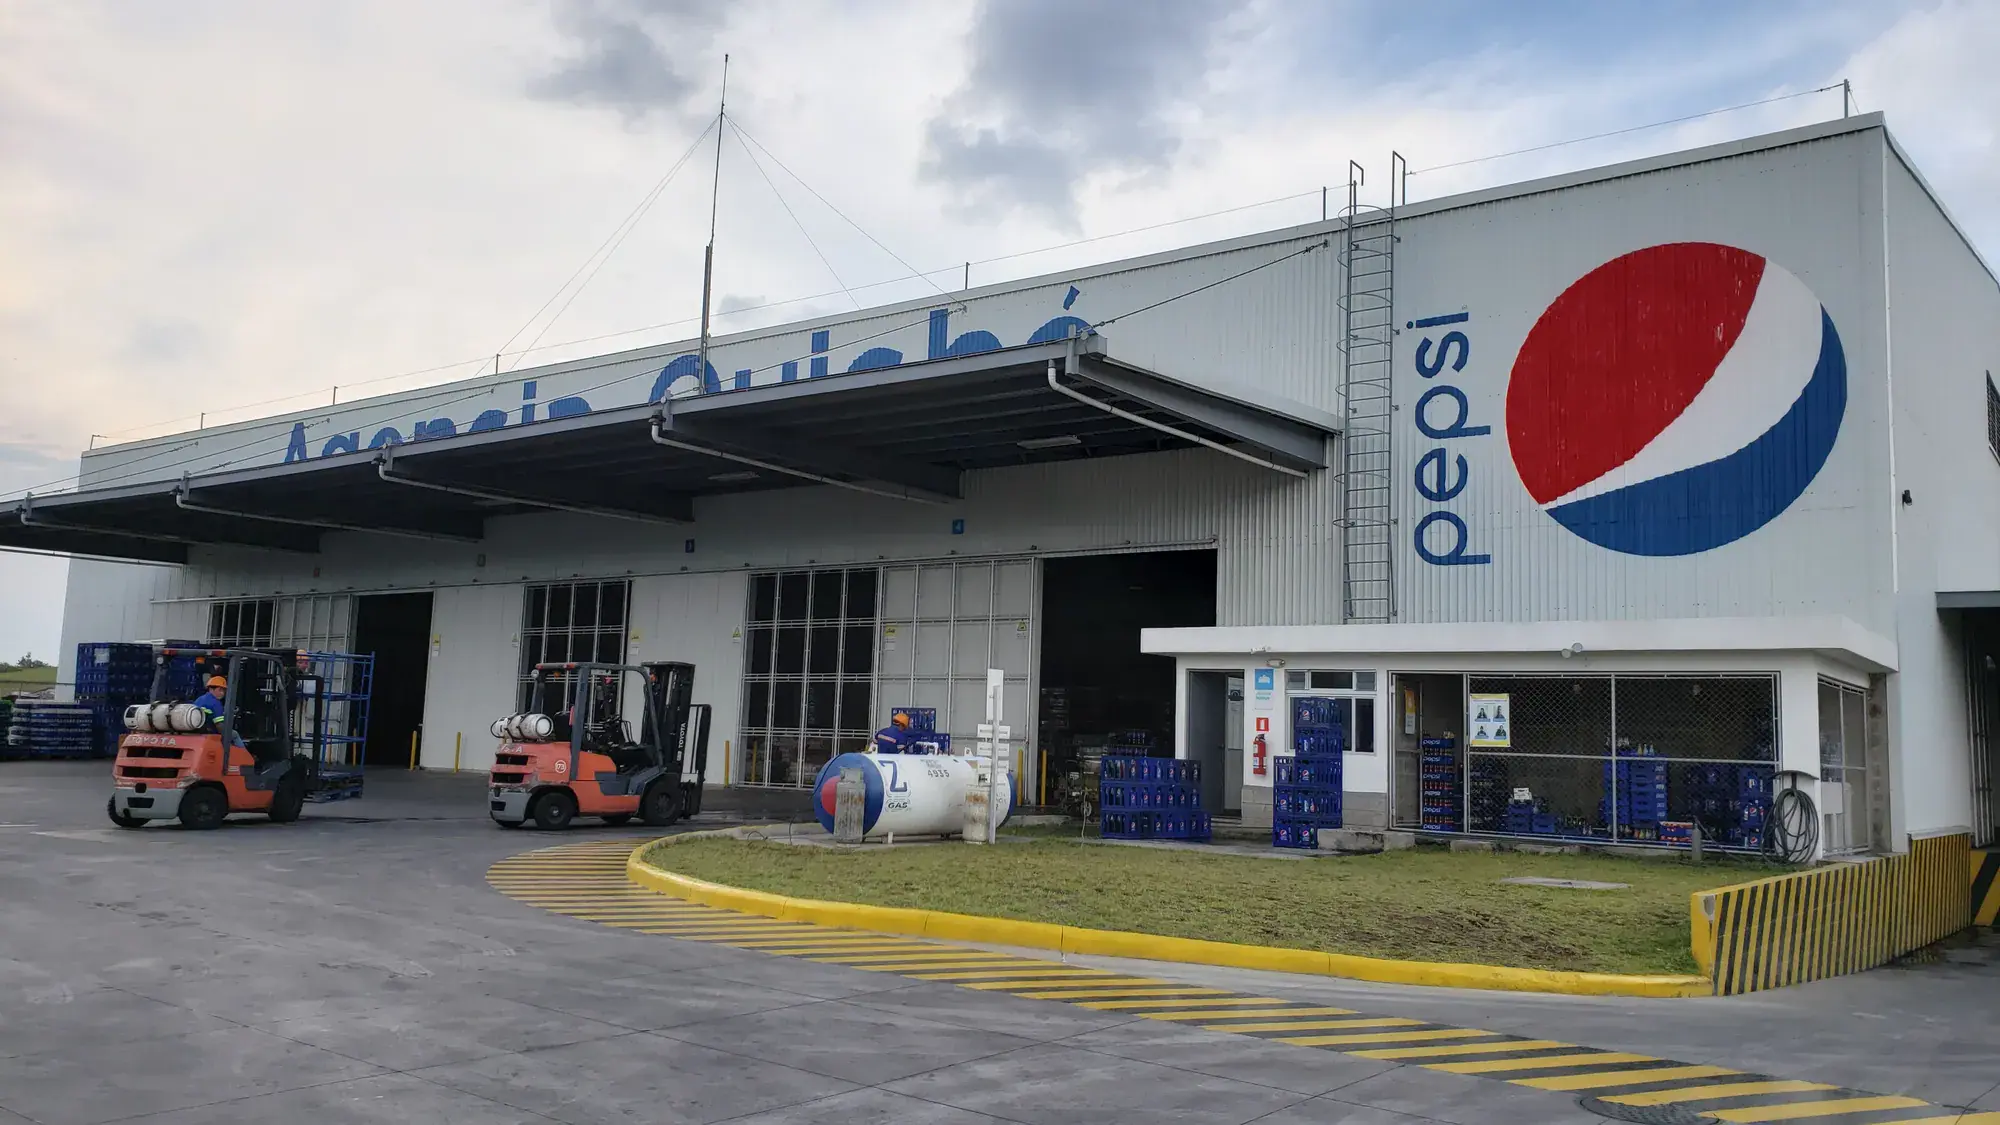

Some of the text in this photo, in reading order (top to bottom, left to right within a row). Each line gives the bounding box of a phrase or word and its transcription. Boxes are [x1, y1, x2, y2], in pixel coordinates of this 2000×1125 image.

[1406, 312, 1491, 566] pepsi
[131, 736, 177, 746] TOYOTA
[678, 722, 686, 748] TOYOTA
[927, 769, 950, 778] 4935
